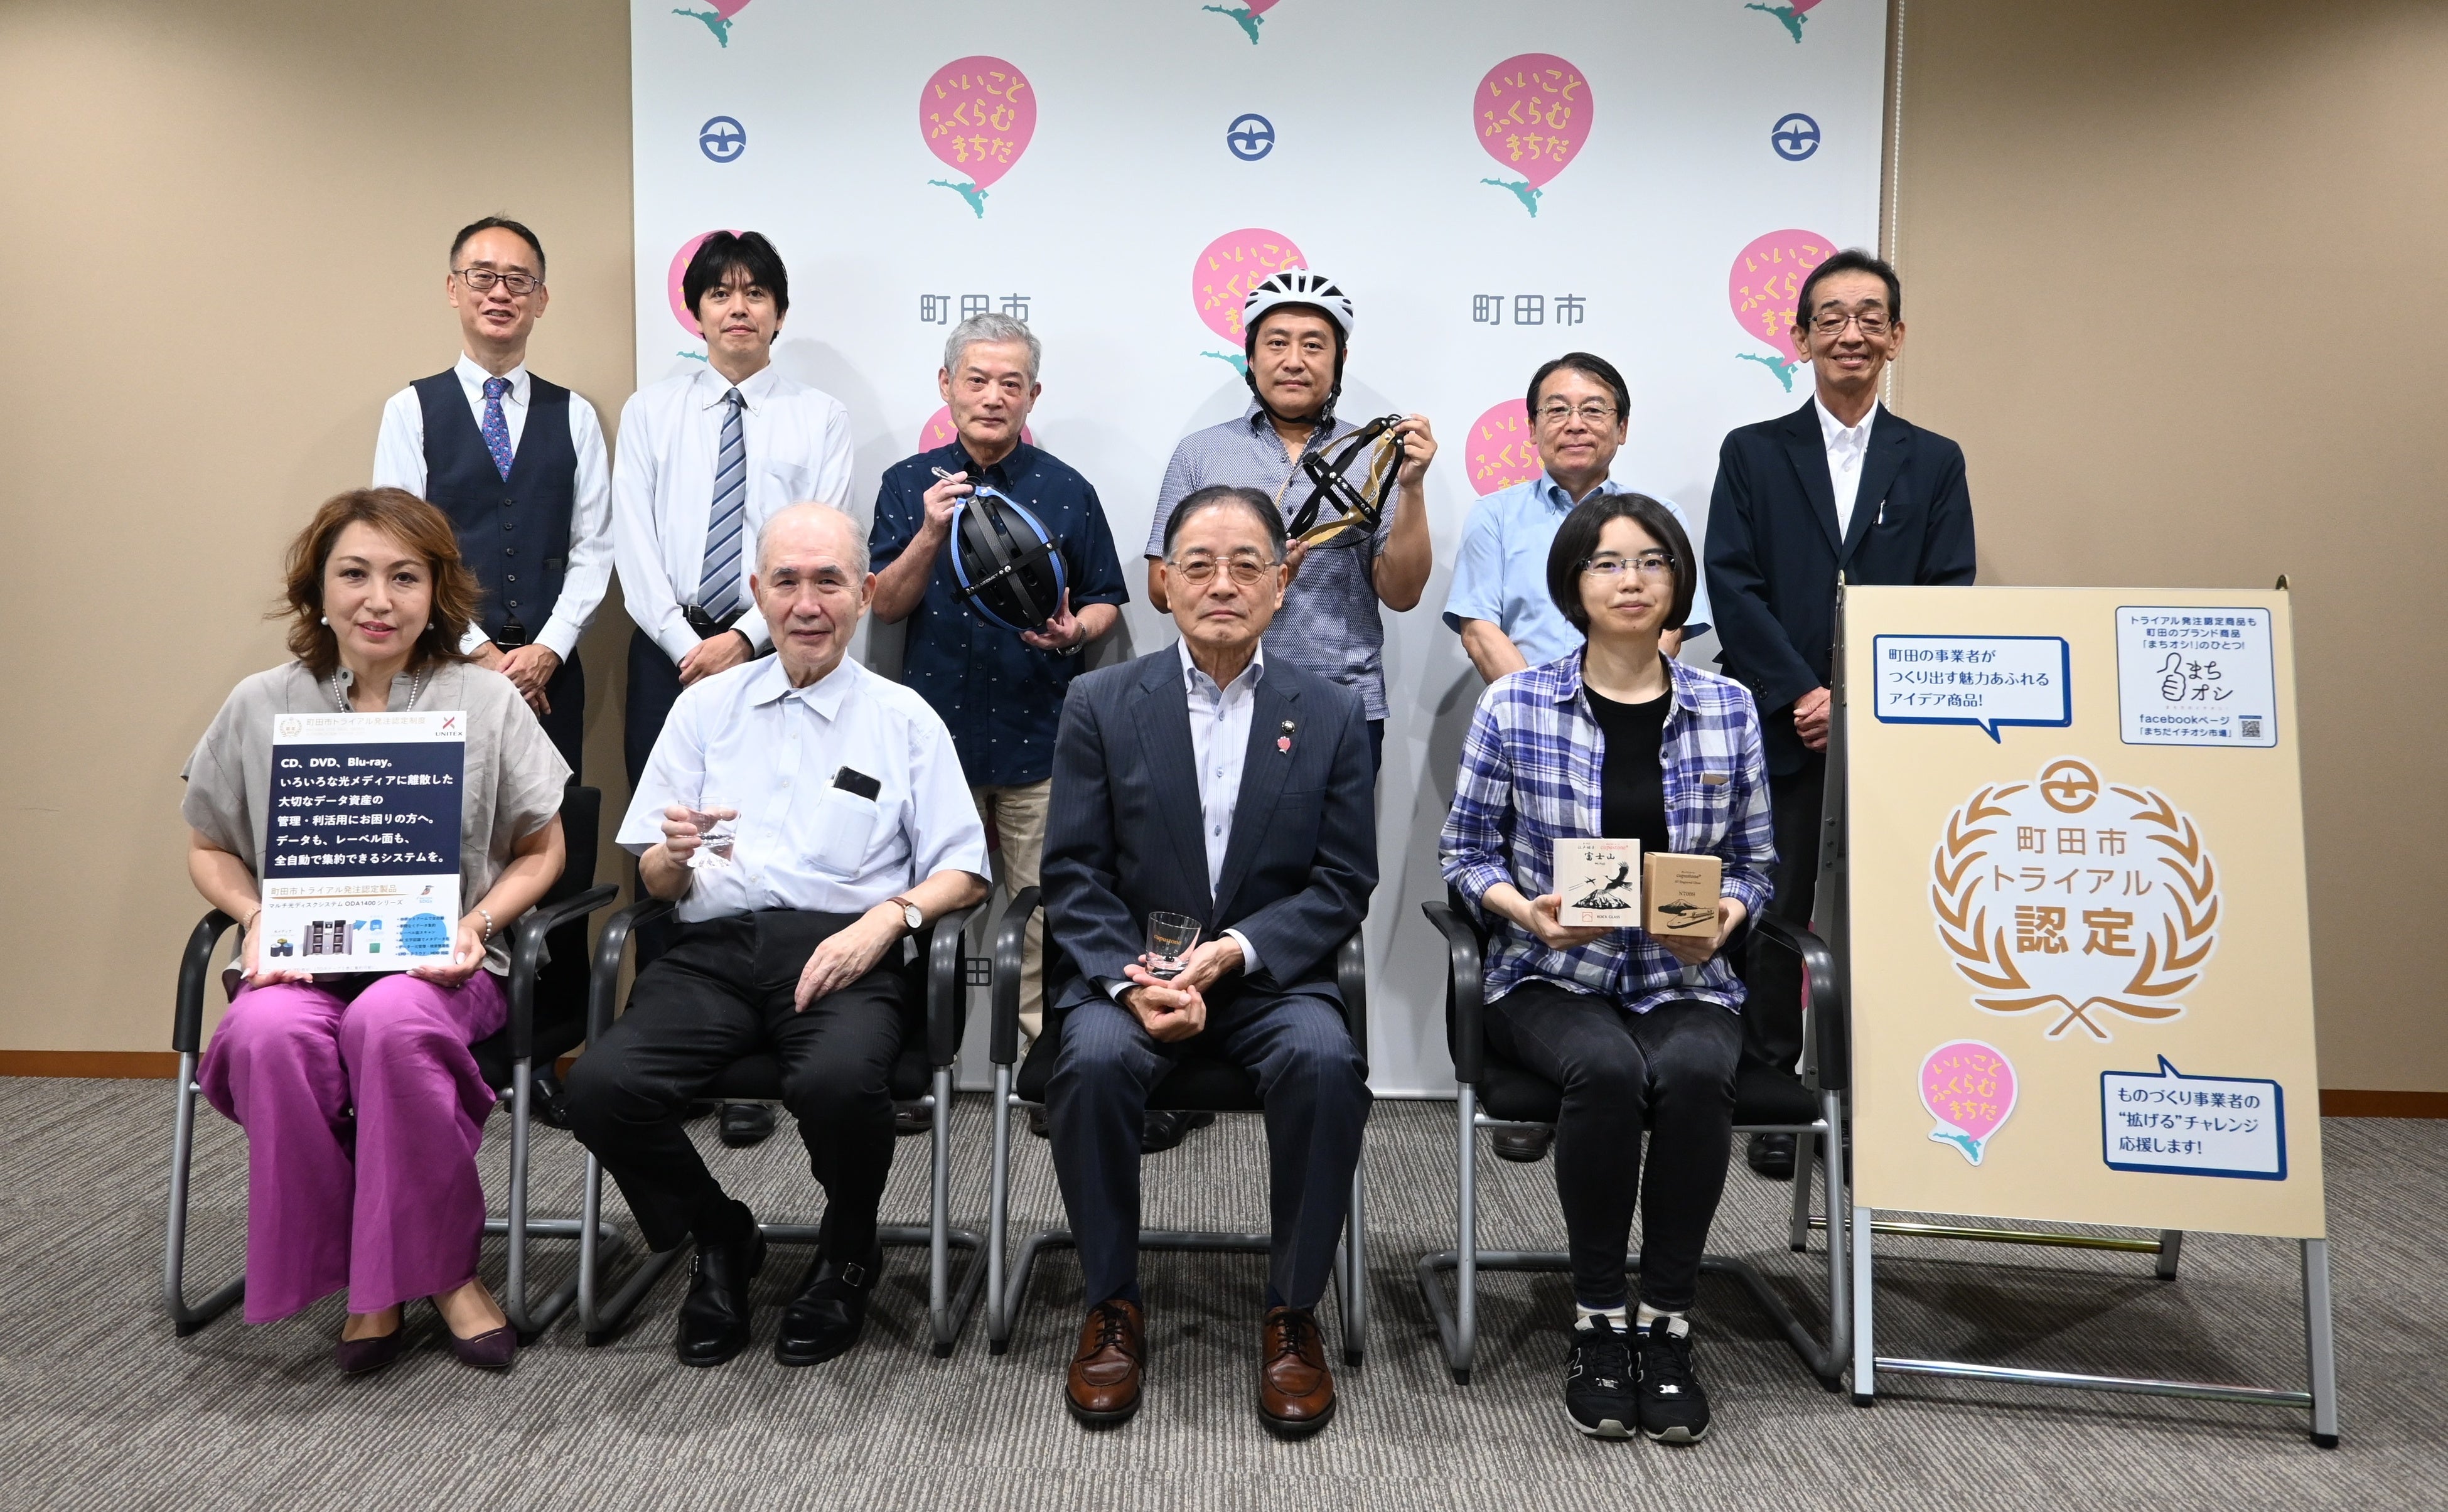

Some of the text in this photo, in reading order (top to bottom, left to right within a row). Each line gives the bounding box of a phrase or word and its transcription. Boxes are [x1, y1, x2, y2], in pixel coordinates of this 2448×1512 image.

[935, 71, 1025, 103] いいこと
[1490, 69, 1582, 101] いいこと
[931, 99, 1015, 139] ふくらむ
[1484, 97, 1571, 137] ふくらむ
[952, 134, 1014, 163] まちだ
[1506, 132, 1569, 162] まちだ
[1746, 245, 1830, 272] いいこ
[1473, 293, 1587, 326] 町田市
[2130, 616, 2257, 626] トライアル発注認定商品も
[2146, 628, 2241, 638] 町田のブランド商品
[1889, 648, 1997, 663] 町田の事業者が
[1889, 671, 2049, 687] つくり出す魅力あふれる
[2186, 660, 2222, 680] まち
[2191, 684, 2233, 701] オシ
[306, 717, 426, 726] 町田市トライアル発注認定制度
[2139, 714, 2230, 726] facebookページ
[280, 773, 454, 788] いろいろな光メディアに離散した
[278, 795, 384, 808] 大切なデータ資産の
[277, 813, 434, 828] 管理・利活用にお困りの方へ。
[276, 833, 411, 847] データも、レーベル面も、
[2017, 825, 2127, 857] 町田市
[274, 852, 444, 867] 全自動で集約できるシステムを。
[1584, 852, 1616, 861] 富士山
[271, 884, 397, 896] 町田市トライアル発注認定製品
[1994, 865, 2153, 897] トライアル
[2014, 904, 2137, 957] 認定
[1933, 1054, 2002, 1078] いいこと
[1930, 1075, 1997, 1104] ふくらむ
[2117, 1087, 2261, 1110] ものづくり事業者の
[1950, 1100, 1997, 1122] まちだ
